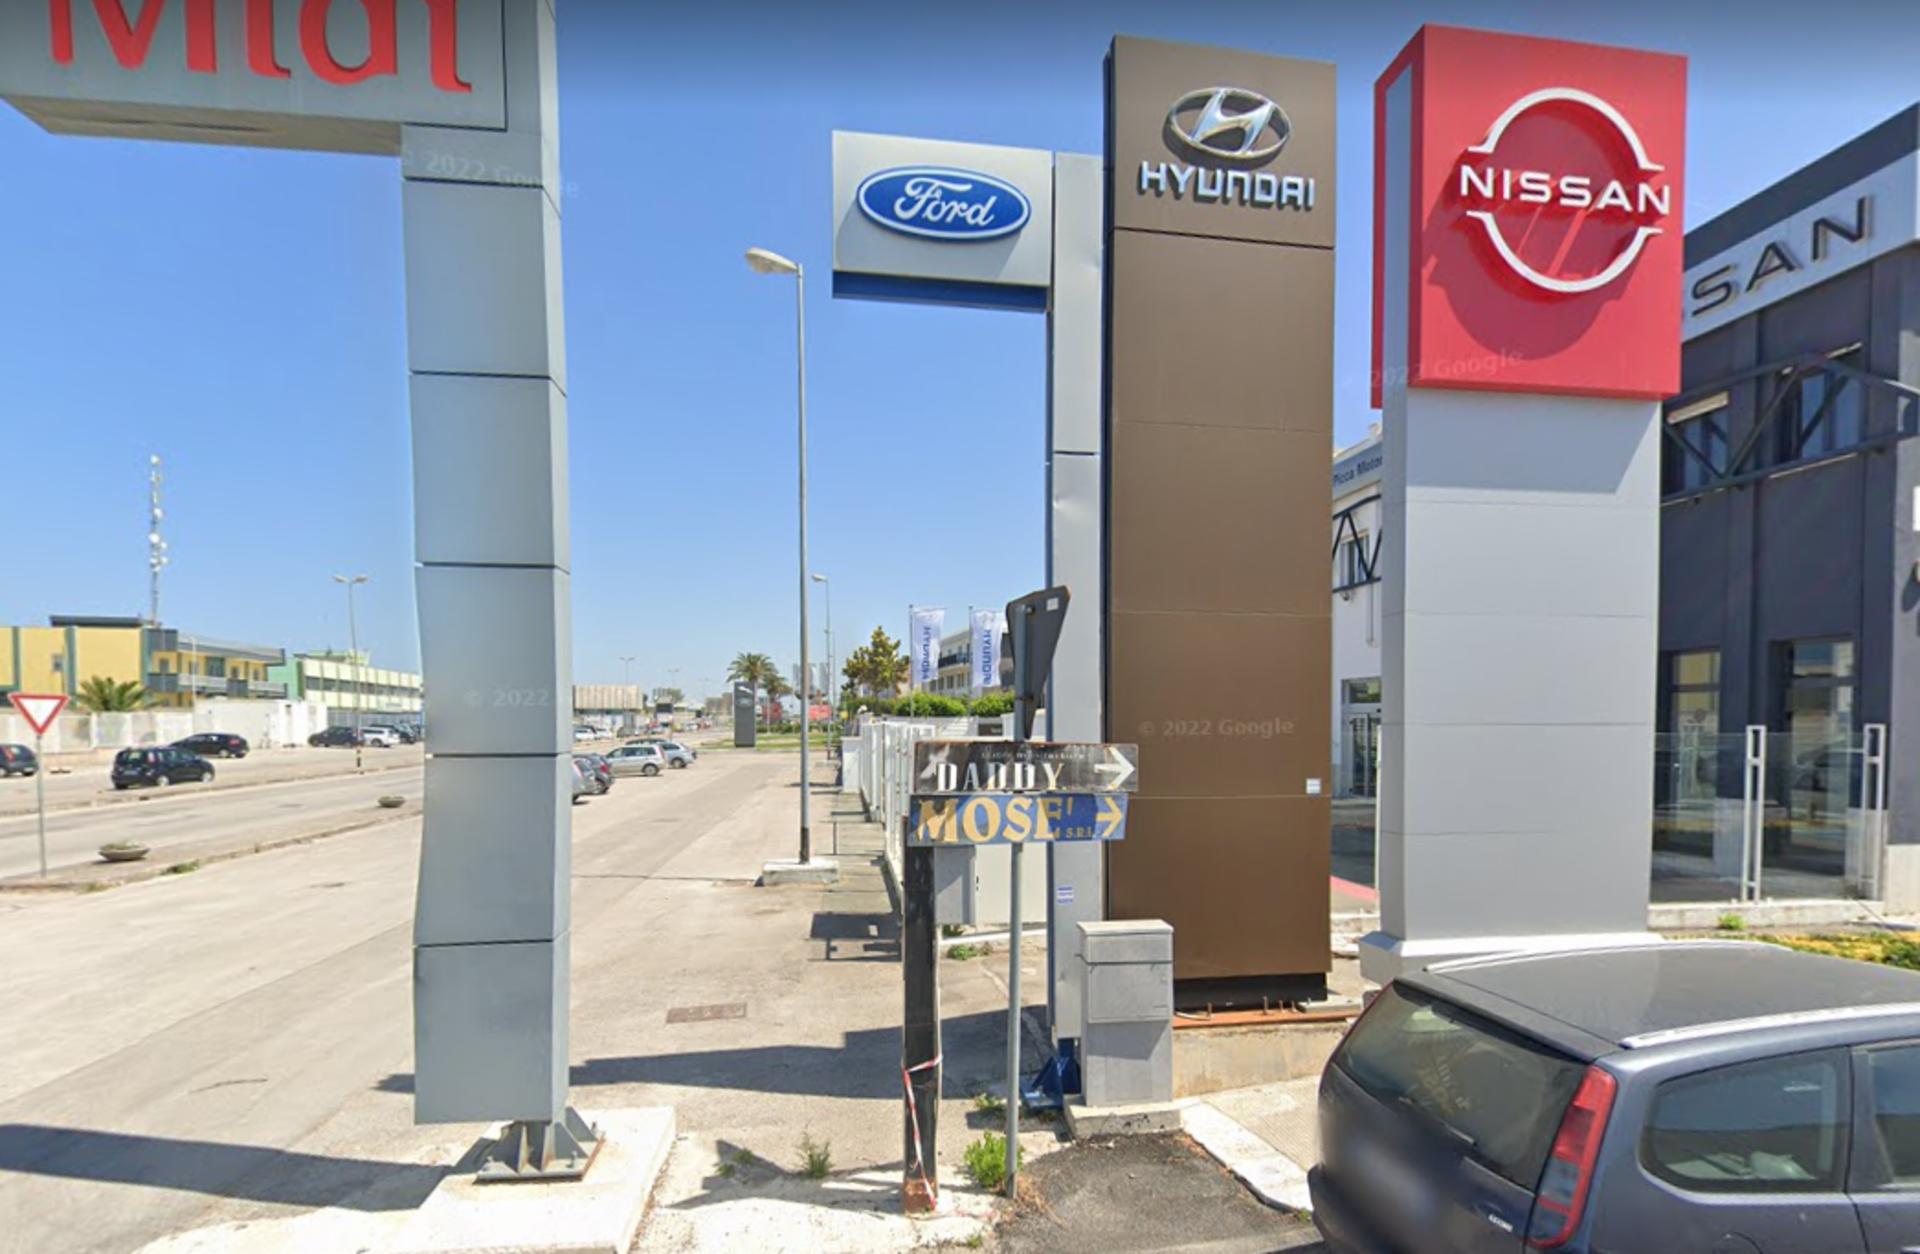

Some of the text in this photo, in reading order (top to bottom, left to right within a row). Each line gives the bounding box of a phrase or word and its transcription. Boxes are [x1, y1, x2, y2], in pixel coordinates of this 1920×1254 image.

[893, 177, 998, 227] Ford
[1140, 160, 1316, 208] HYUNDAI
[1460, 164, 1671, 216] NISSAN
[1682, 196, 1872, 318] SAN
